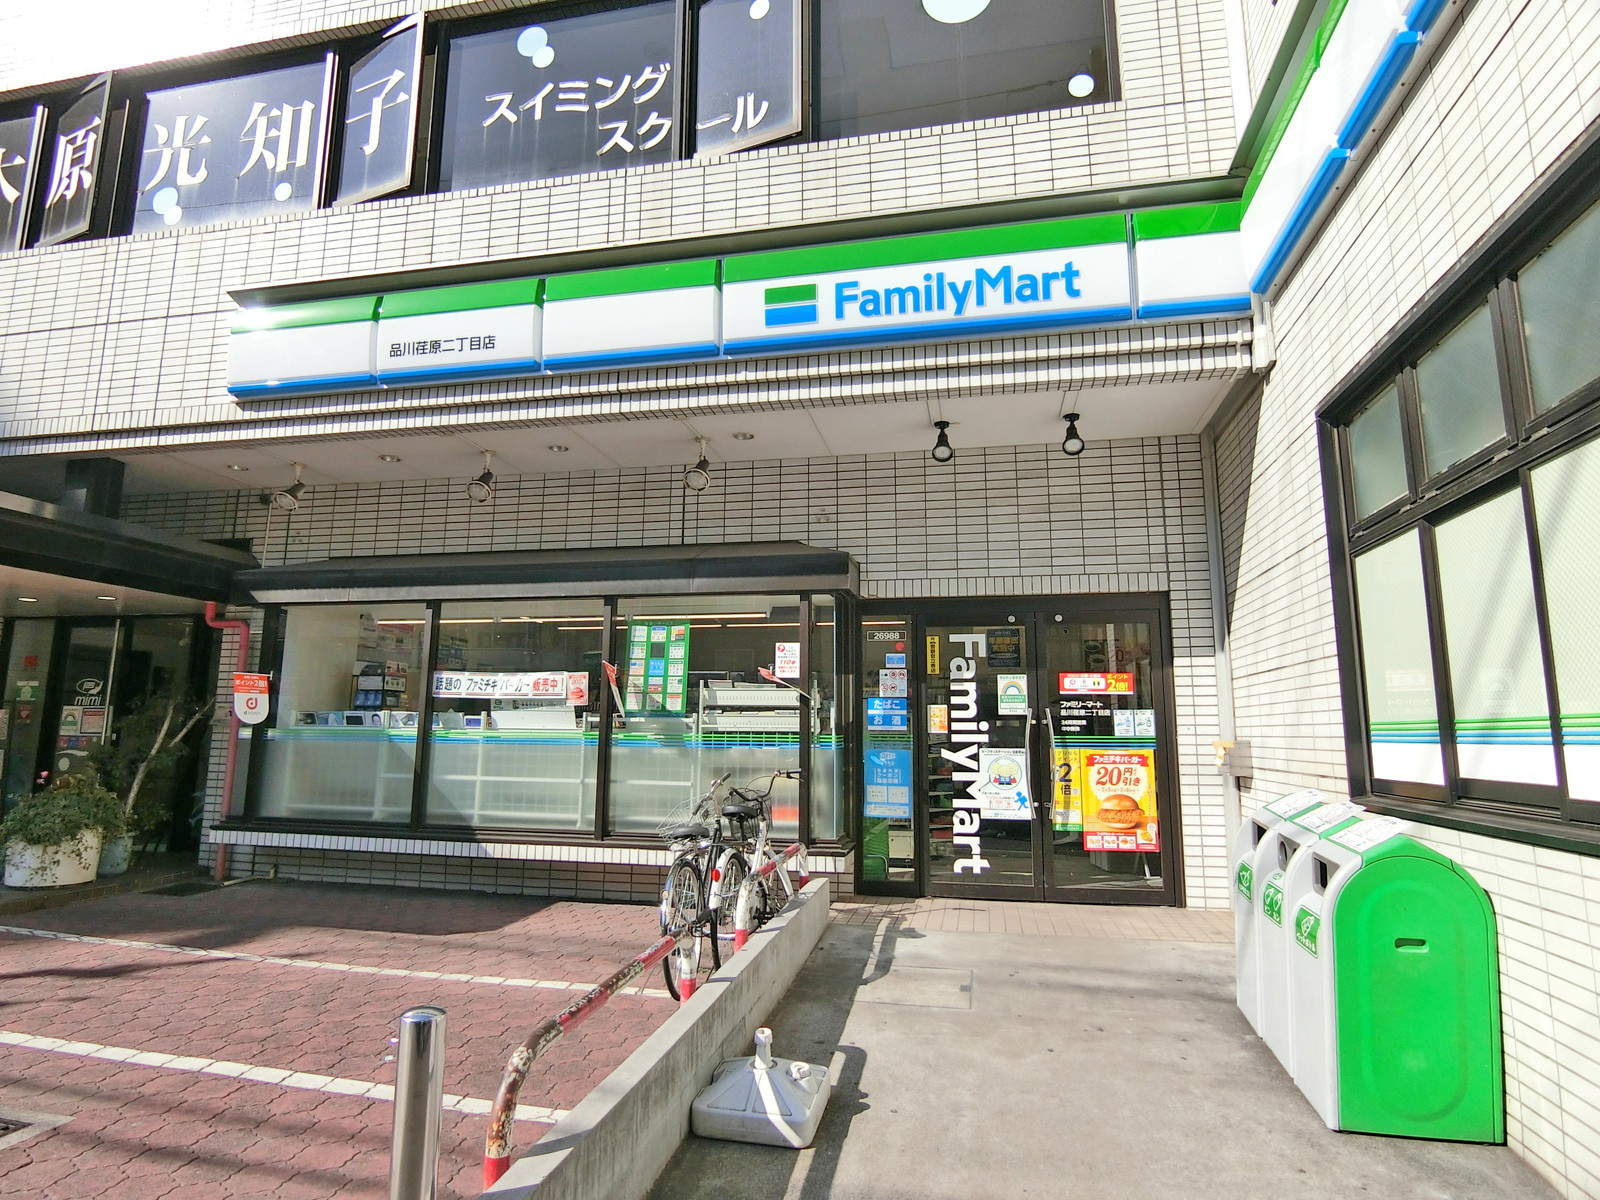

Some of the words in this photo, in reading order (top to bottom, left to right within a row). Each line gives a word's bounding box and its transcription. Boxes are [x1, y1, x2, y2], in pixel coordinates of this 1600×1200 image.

[482, 61, 671, 128] スイミング
[596, 91, 769, 157] スクール
[834, 260, 1081, 320] FamilyMart
[389, 335, 496, 358] 品川荏原二丁目店
[873, 632, 900, 640] 26988
[1106, 680, 1128, 692] 2倍!
[873, 699, 901, 710] たばこ
[940, 633, 991, 875] FamilyMart
[1092, 755, 1142, 764] ファミチキバーガー
[1059, 762, 1073, 783] 2
[1060, 783, 1071, 796] 倍
